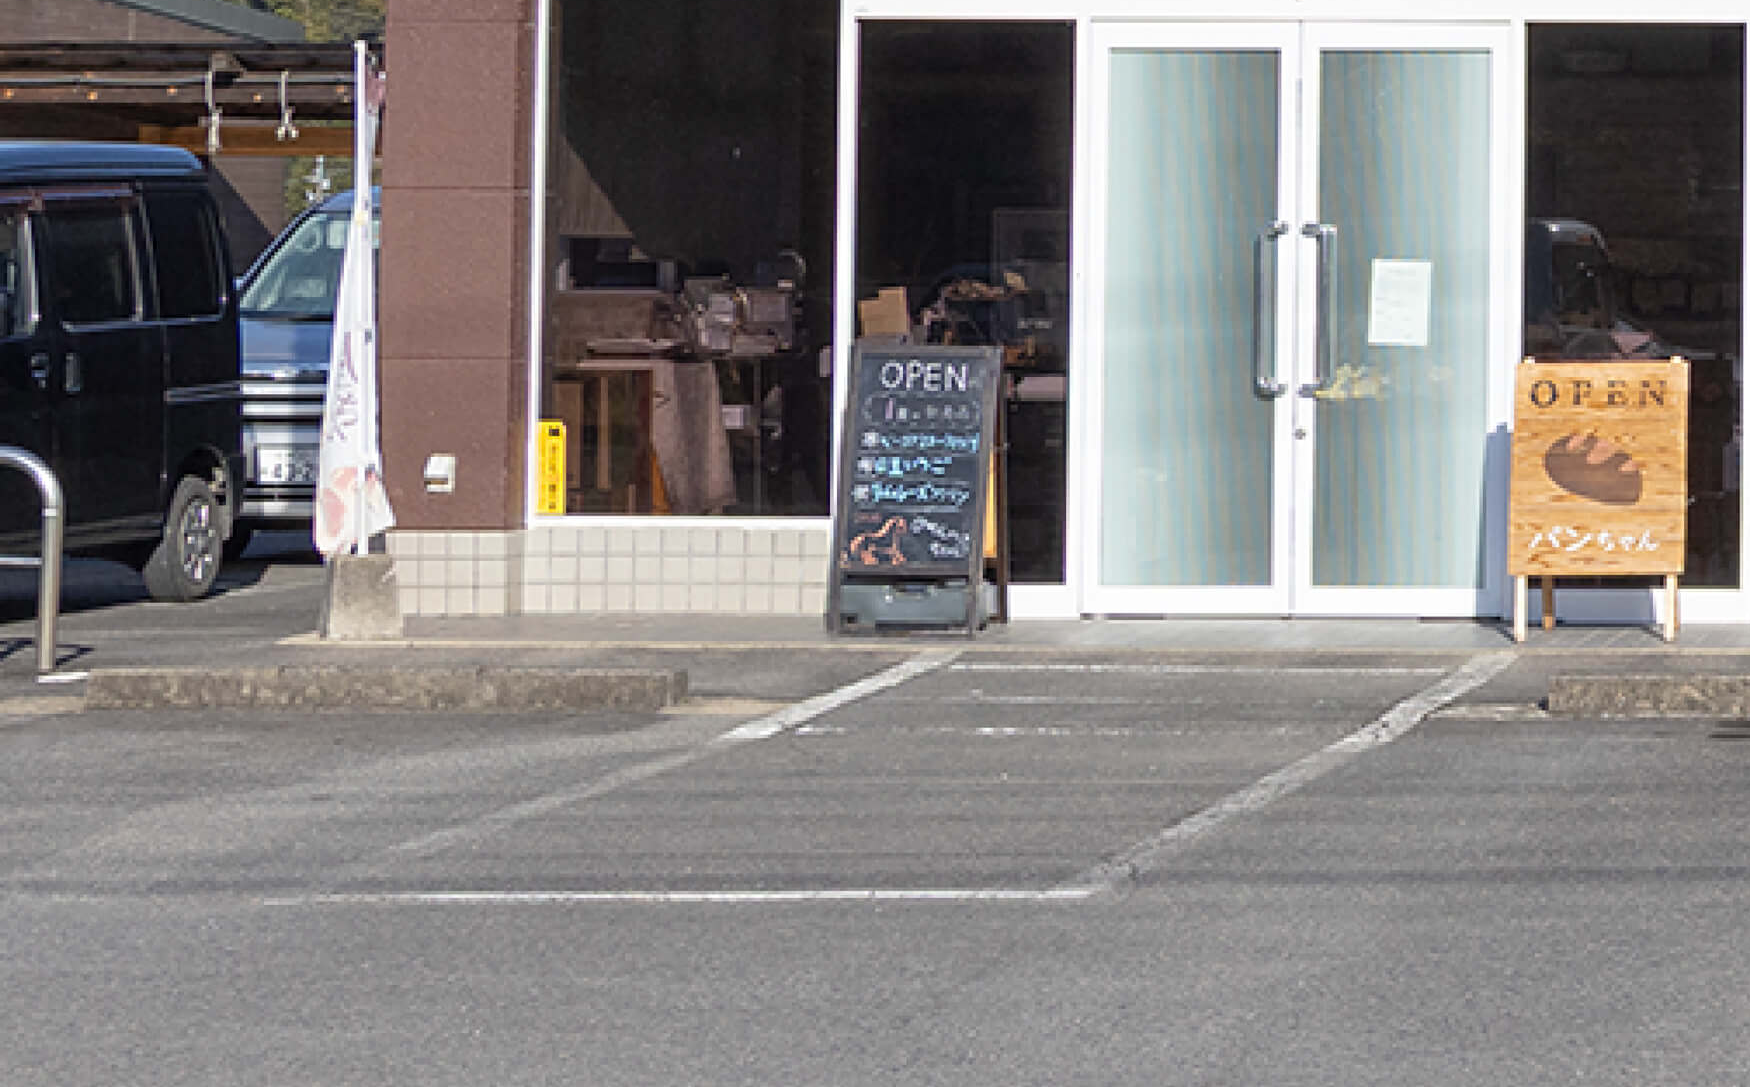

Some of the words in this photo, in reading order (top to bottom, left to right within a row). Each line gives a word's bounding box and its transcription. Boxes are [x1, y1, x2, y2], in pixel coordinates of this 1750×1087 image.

[880, 360, 969, 392] OPEN
[1529, 380, 1668, 409] OPEN
[1528, 526, 1659, 552] パンちゃん
